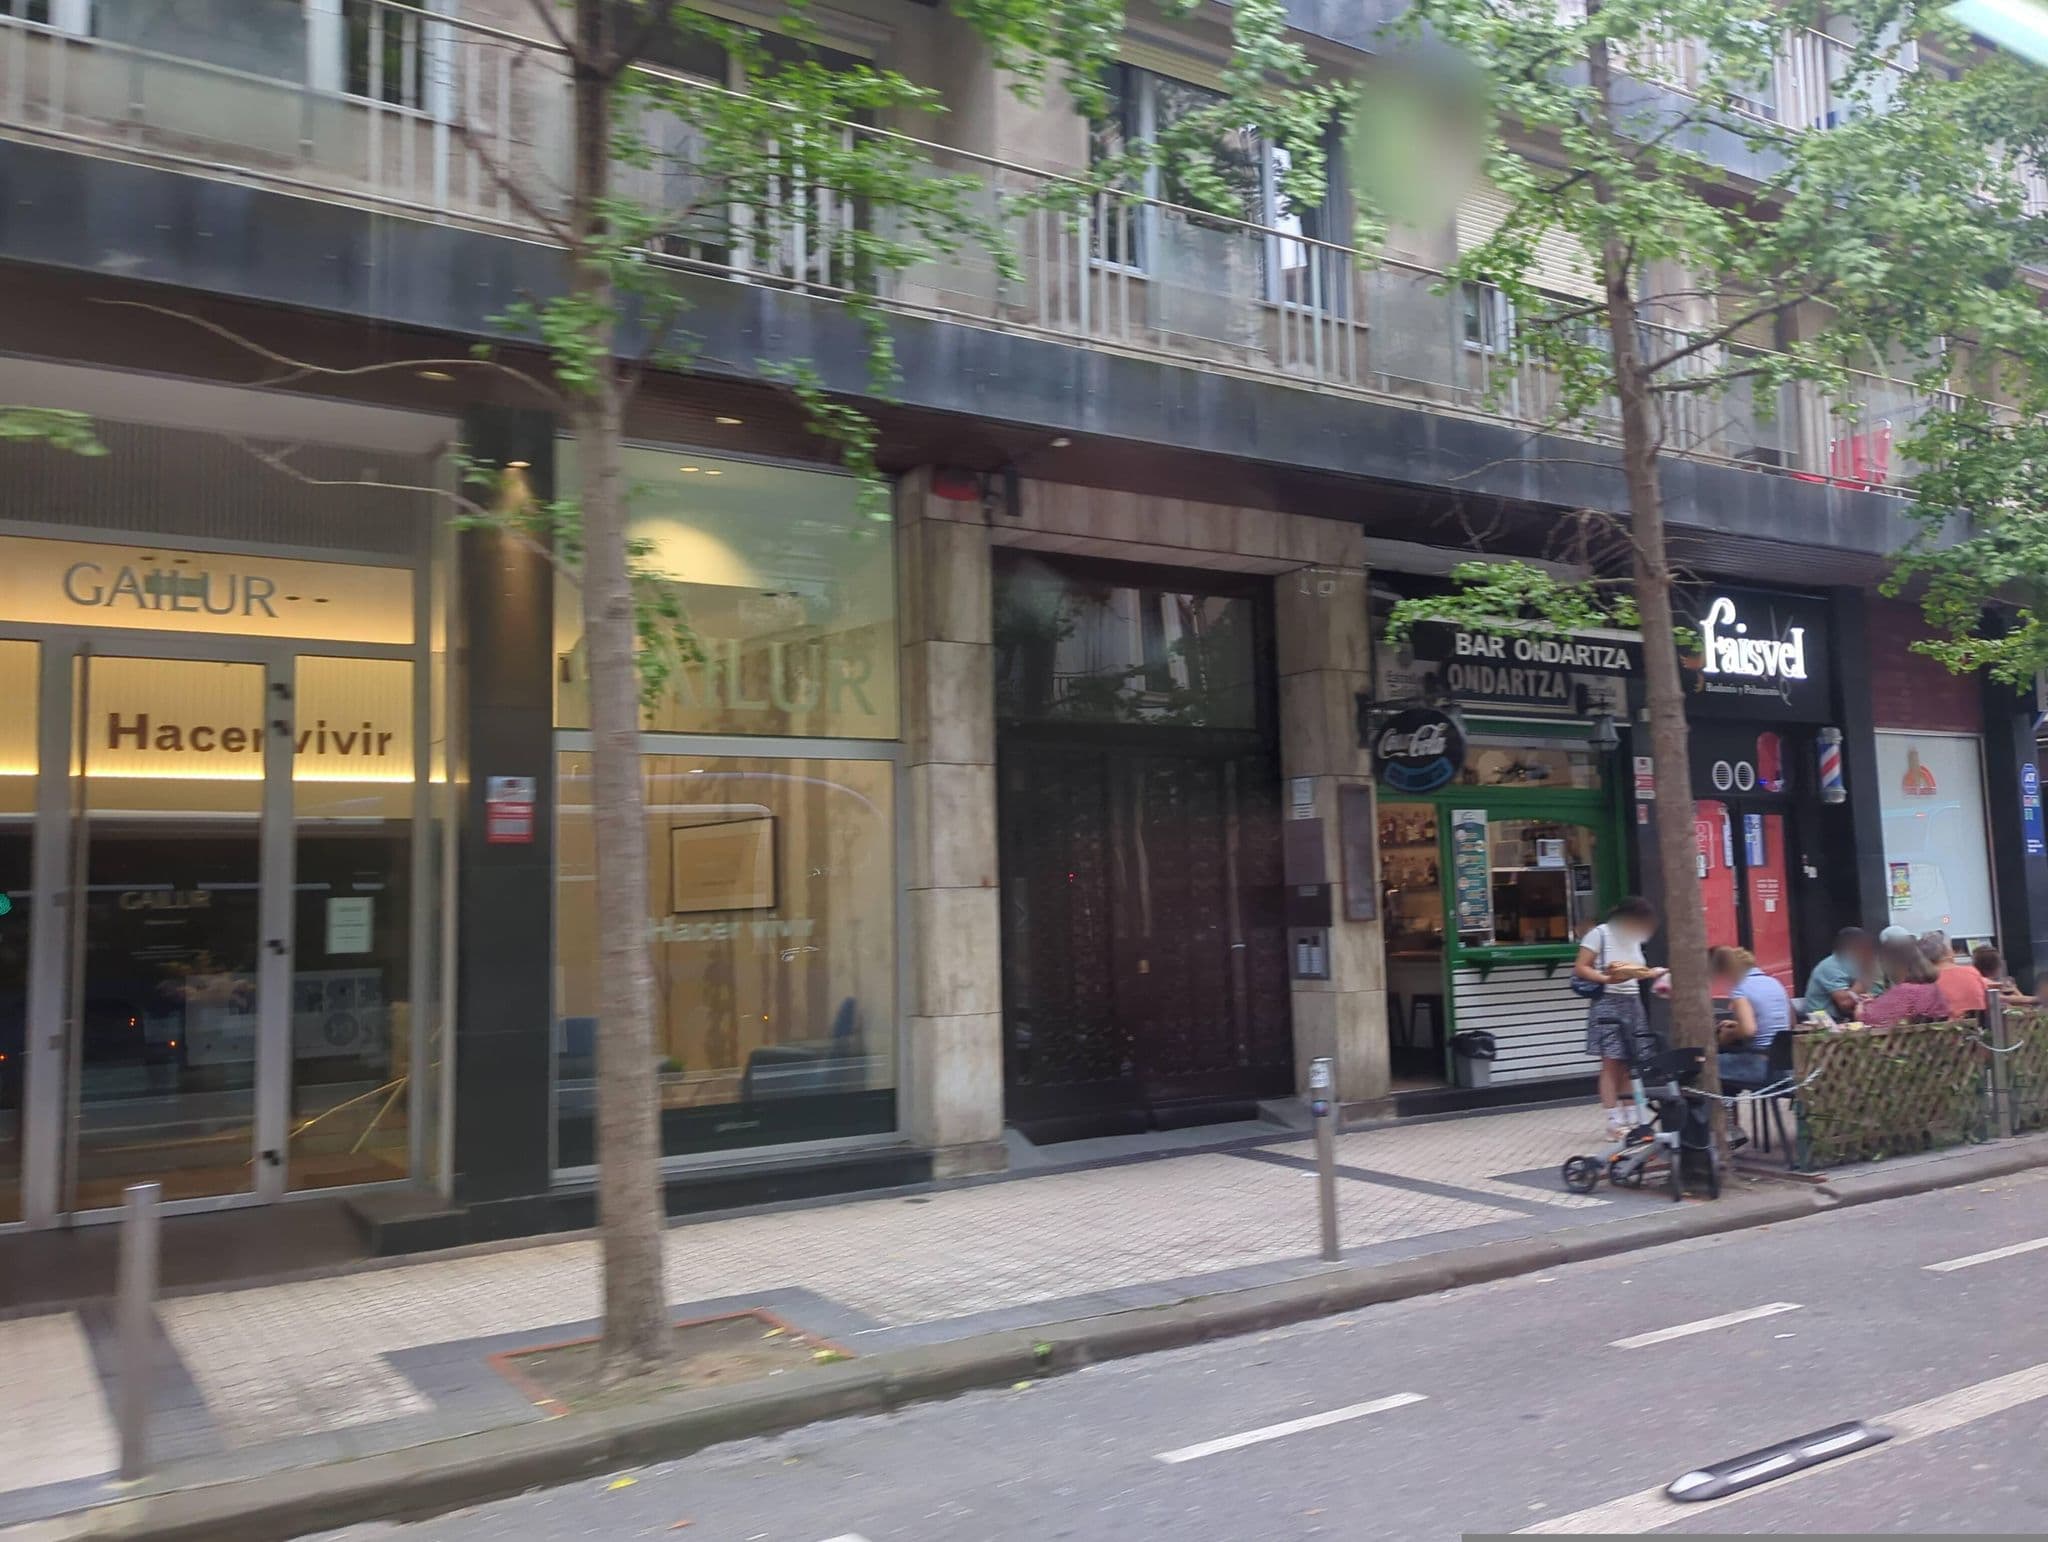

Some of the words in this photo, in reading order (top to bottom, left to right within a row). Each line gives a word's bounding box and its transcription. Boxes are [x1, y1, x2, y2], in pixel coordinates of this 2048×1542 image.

[63, 562, 279, 618] GAILUR
[1455, 632, 1506, 659] BAR
[1514, 638, 1632, 670] ONDARTZA
[1448, 663, 1568, 698] ONDARTZA
[107, 712, 266, 753] Hacer
[293, 719, 393, 757] vivir
